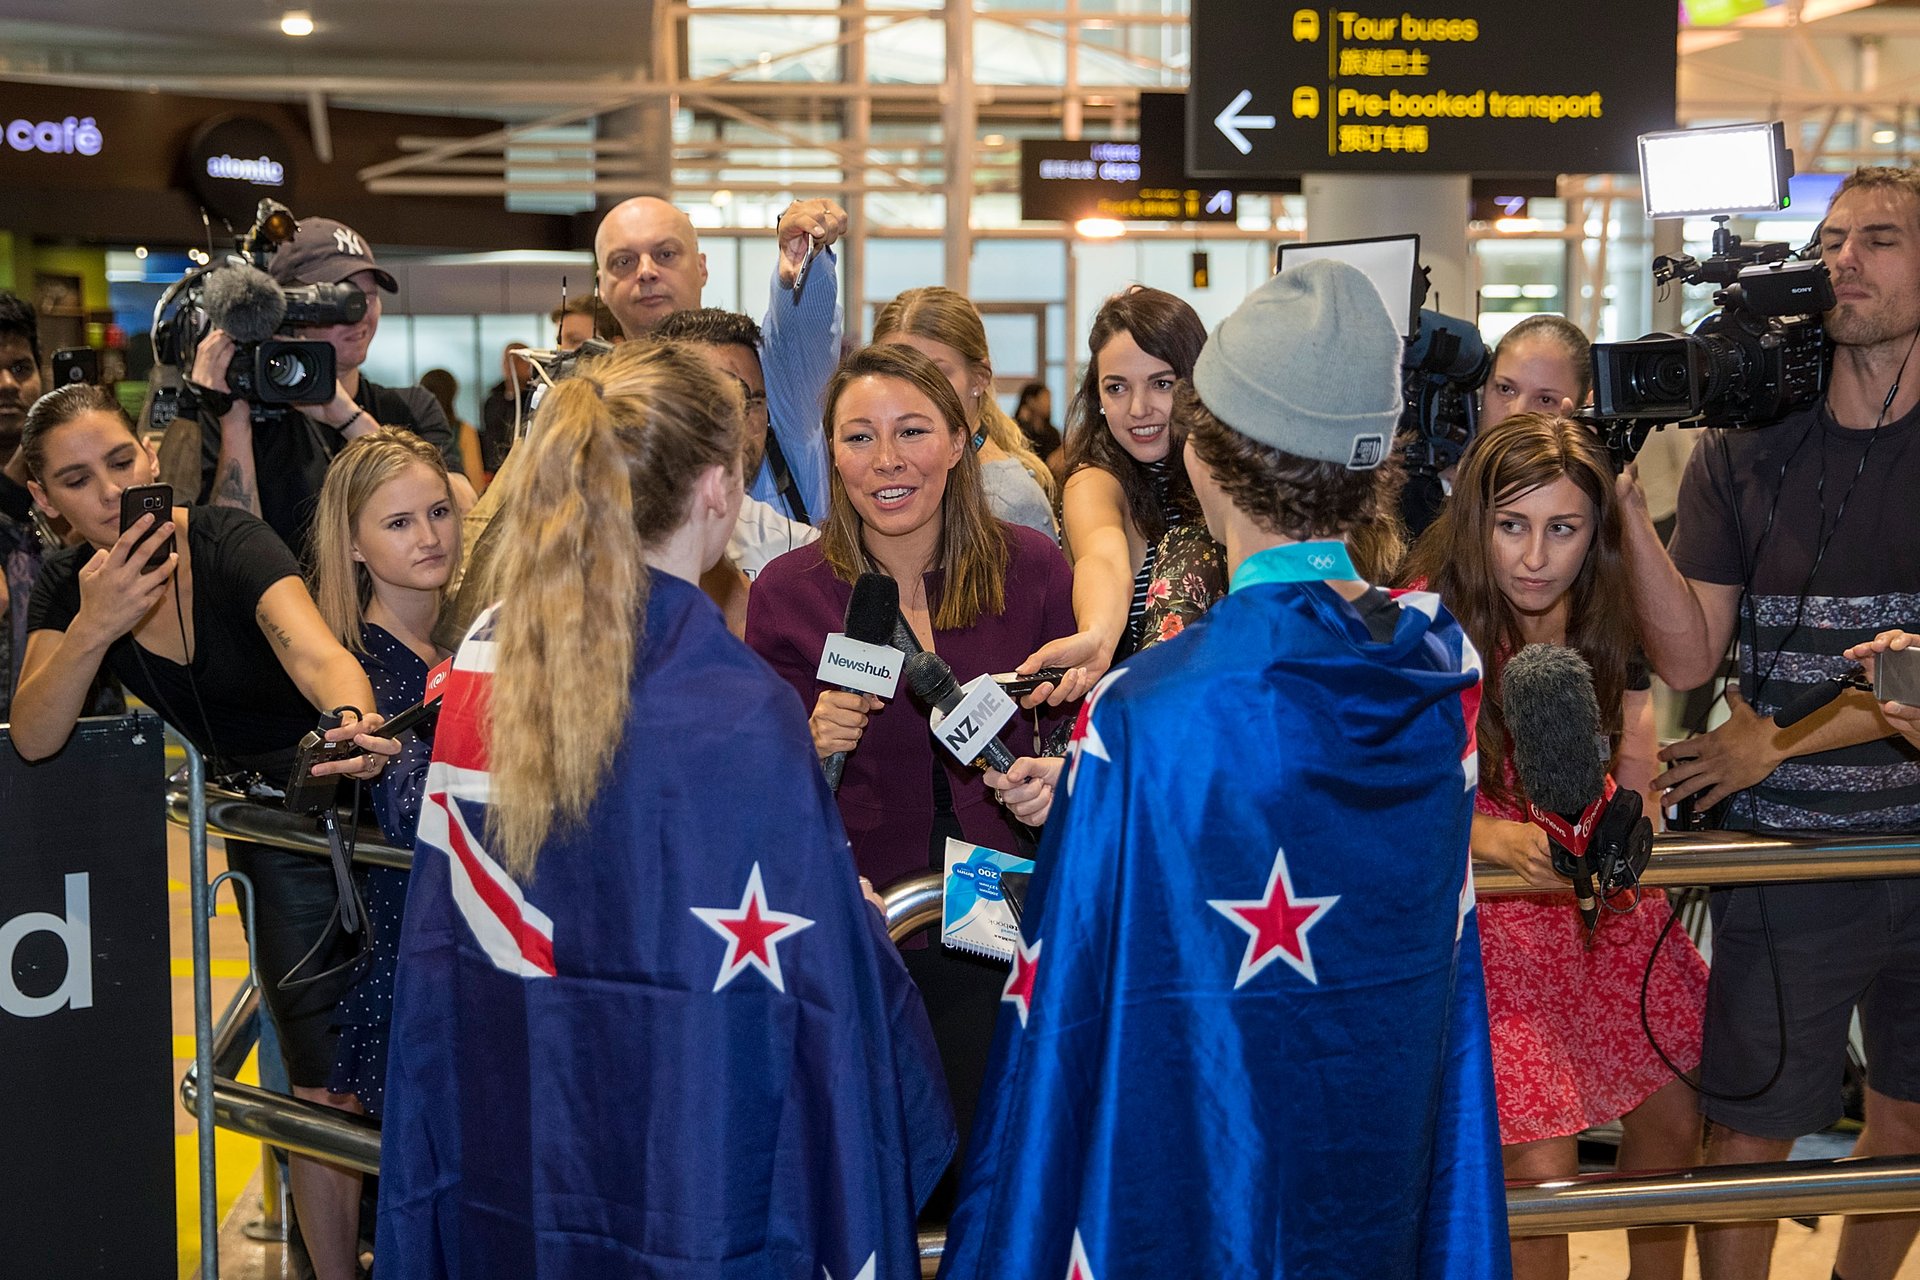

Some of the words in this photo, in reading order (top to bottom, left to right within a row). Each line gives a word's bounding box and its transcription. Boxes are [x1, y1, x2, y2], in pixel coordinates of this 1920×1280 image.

[1338, 11, 1399, 41] Tour
[1401, 12, 1479, 42] buses
[1338, 88, 1485, 118] Pre-booked
[1488, 90, 1603, 123] transport
[6, 116, 103, 156] café
[1791, 286, 1813, 294] SONY
[978, 868, 998, 880] 200
[988, 919, 1019, 932] tebook
